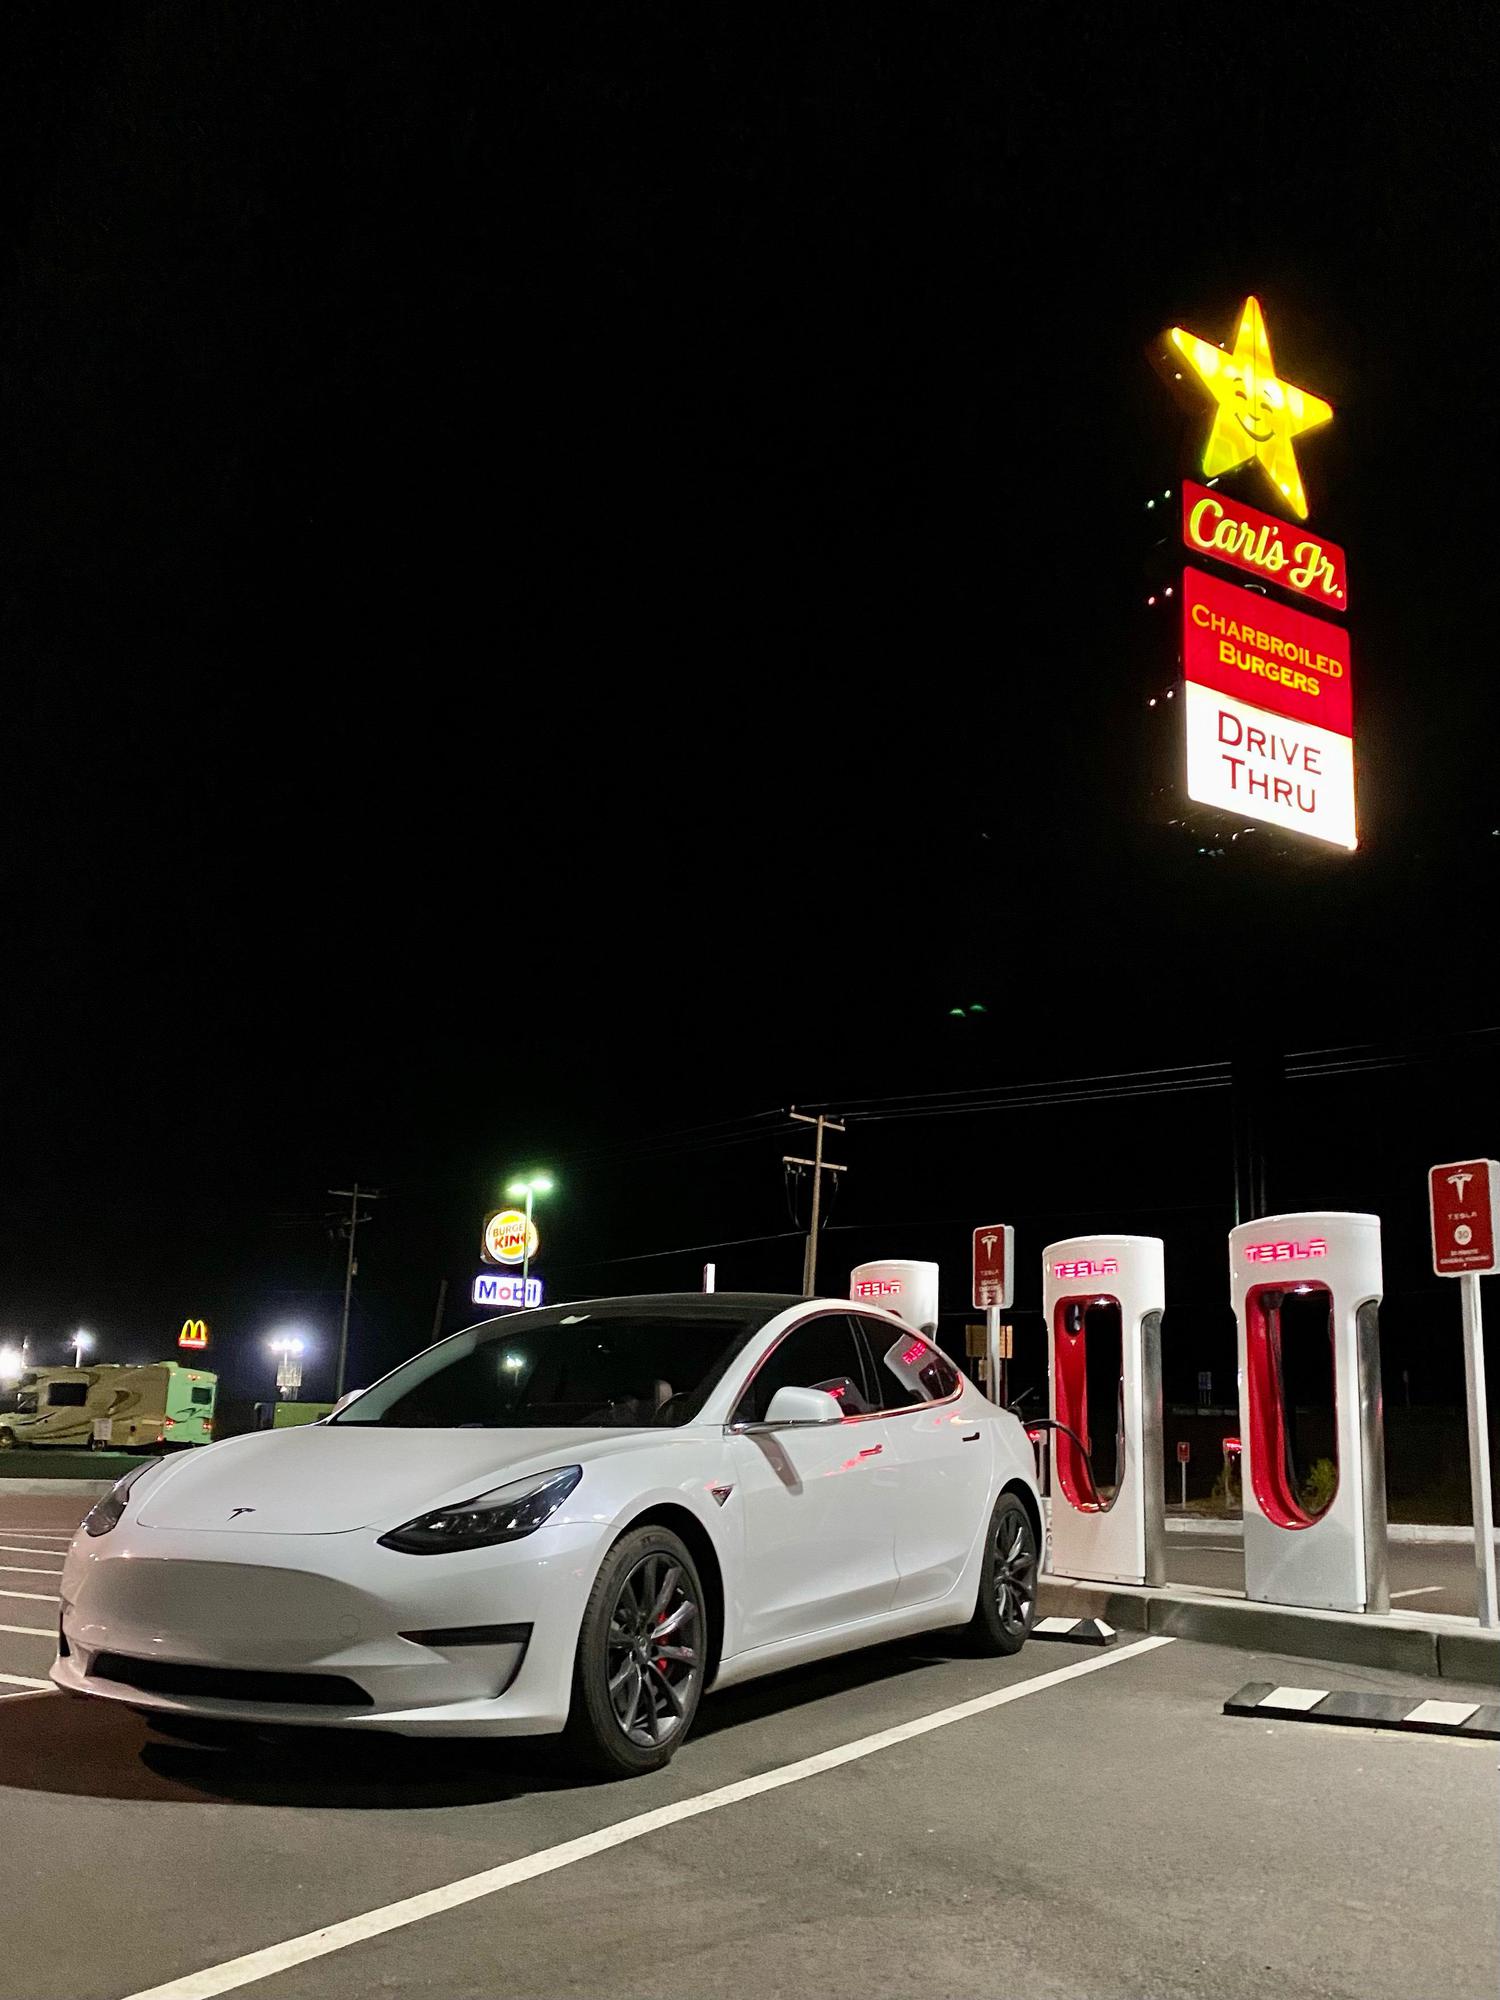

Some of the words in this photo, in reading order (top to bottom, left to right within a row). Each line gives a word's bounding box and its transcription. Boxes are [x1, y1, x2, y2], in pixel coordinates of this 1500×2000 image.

[1189, 498, 1289, 571] Carl's
[1289, 541, 1343, 598] Jr.
[1191, 603, 1343, 678] CHARBROILED
[1219, 640, 1320, 696] BURGERS
[1217, 709, 1322, 775] DRIVE
[1221, 753, 1316, 813] THRU
[493, 1223, 525, 1238] BURGE
[1244, 1238, 1328, 1263] TESLA
[856, 1280, 901, 1296] TESLA
[1054, 1258, 1119, 1279] TESLA
[478, 1280, 537, 1302] Mobil
